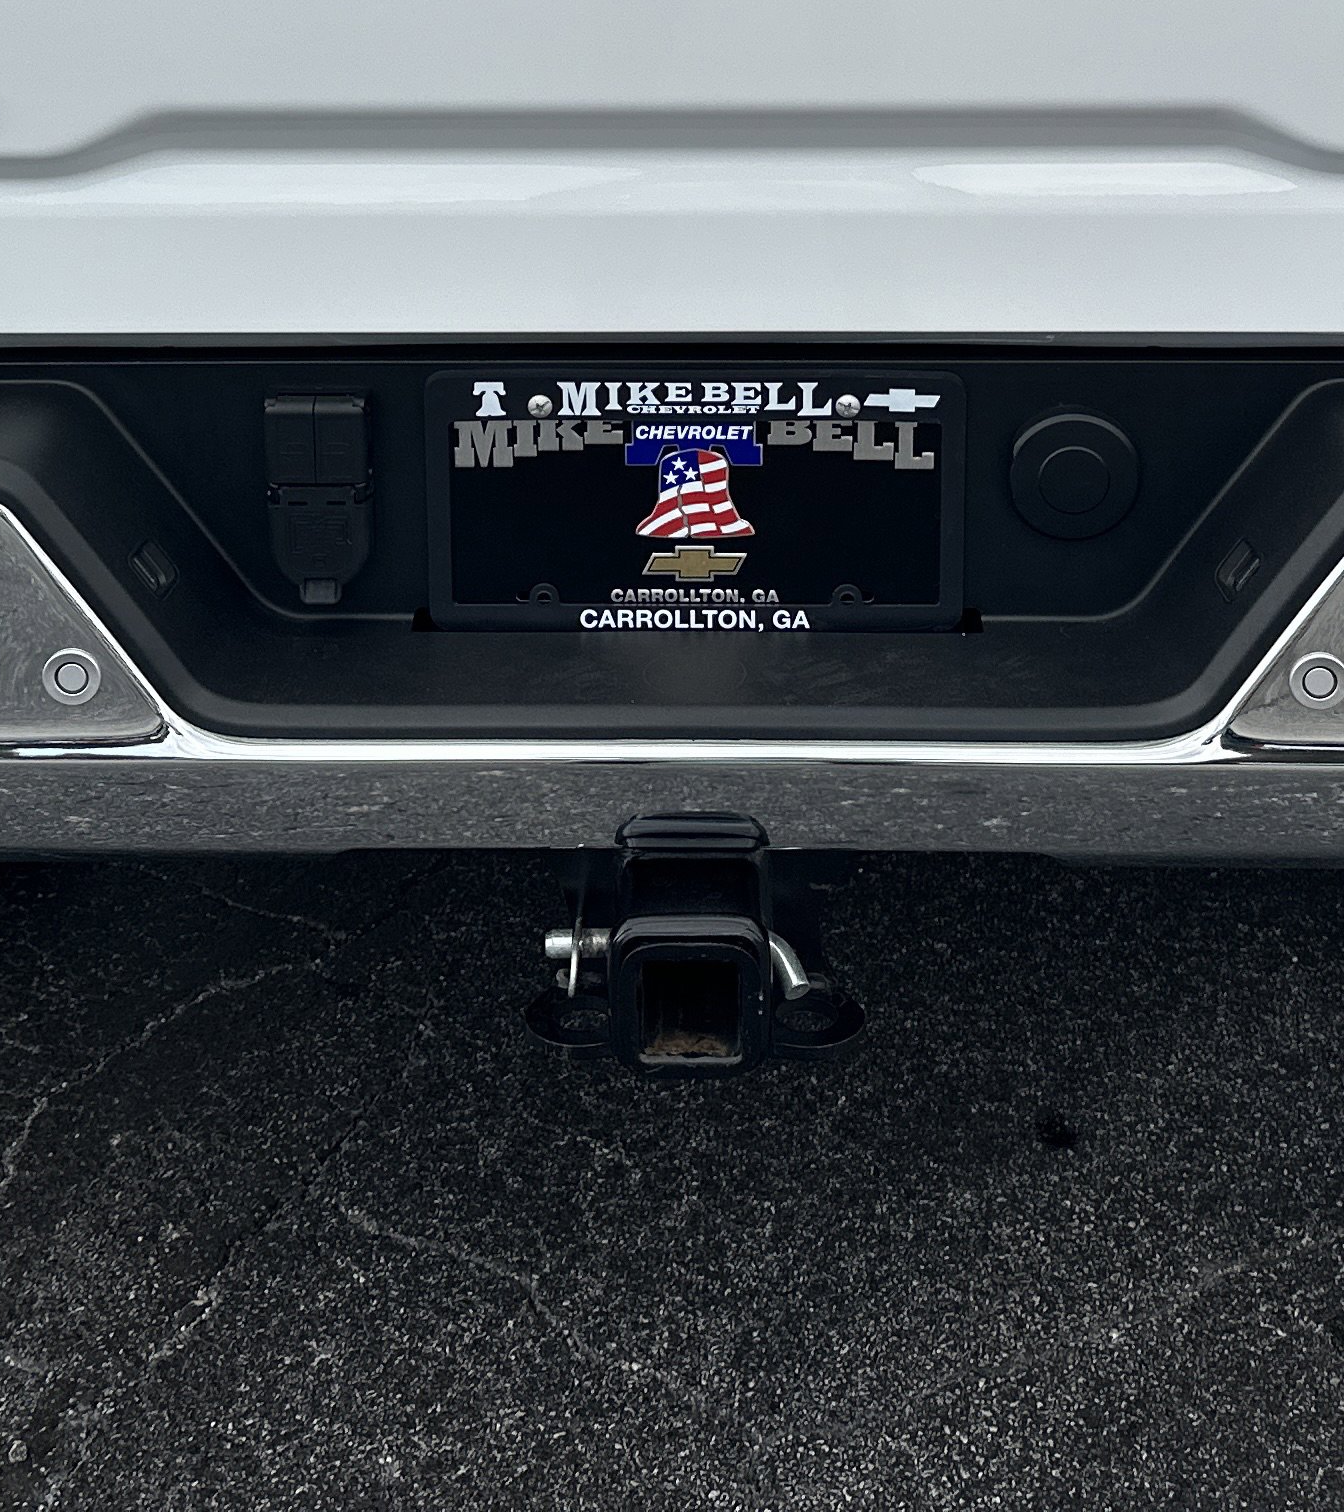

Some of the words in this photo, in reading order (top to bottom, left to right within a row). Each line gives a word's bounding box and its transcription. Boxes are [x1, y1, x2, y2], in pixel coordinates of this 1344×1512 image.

[557, 381, 692, 417] MIKE
[701, 381, 833, 416] BELL
[626, 403, 760, 415] CHEVROLET
[635, 424, 754, 441] CHEVROLET
[454, 419, 624, 468] MIKE
[767, 420, 935, 470] BELL
[610, 588, 746, 604] CARROLLTON,
[752, 588, 780, 603] GA
[579, 608, 764, 632] CARROLLTON,
[773, 609, 810, 630] GA
